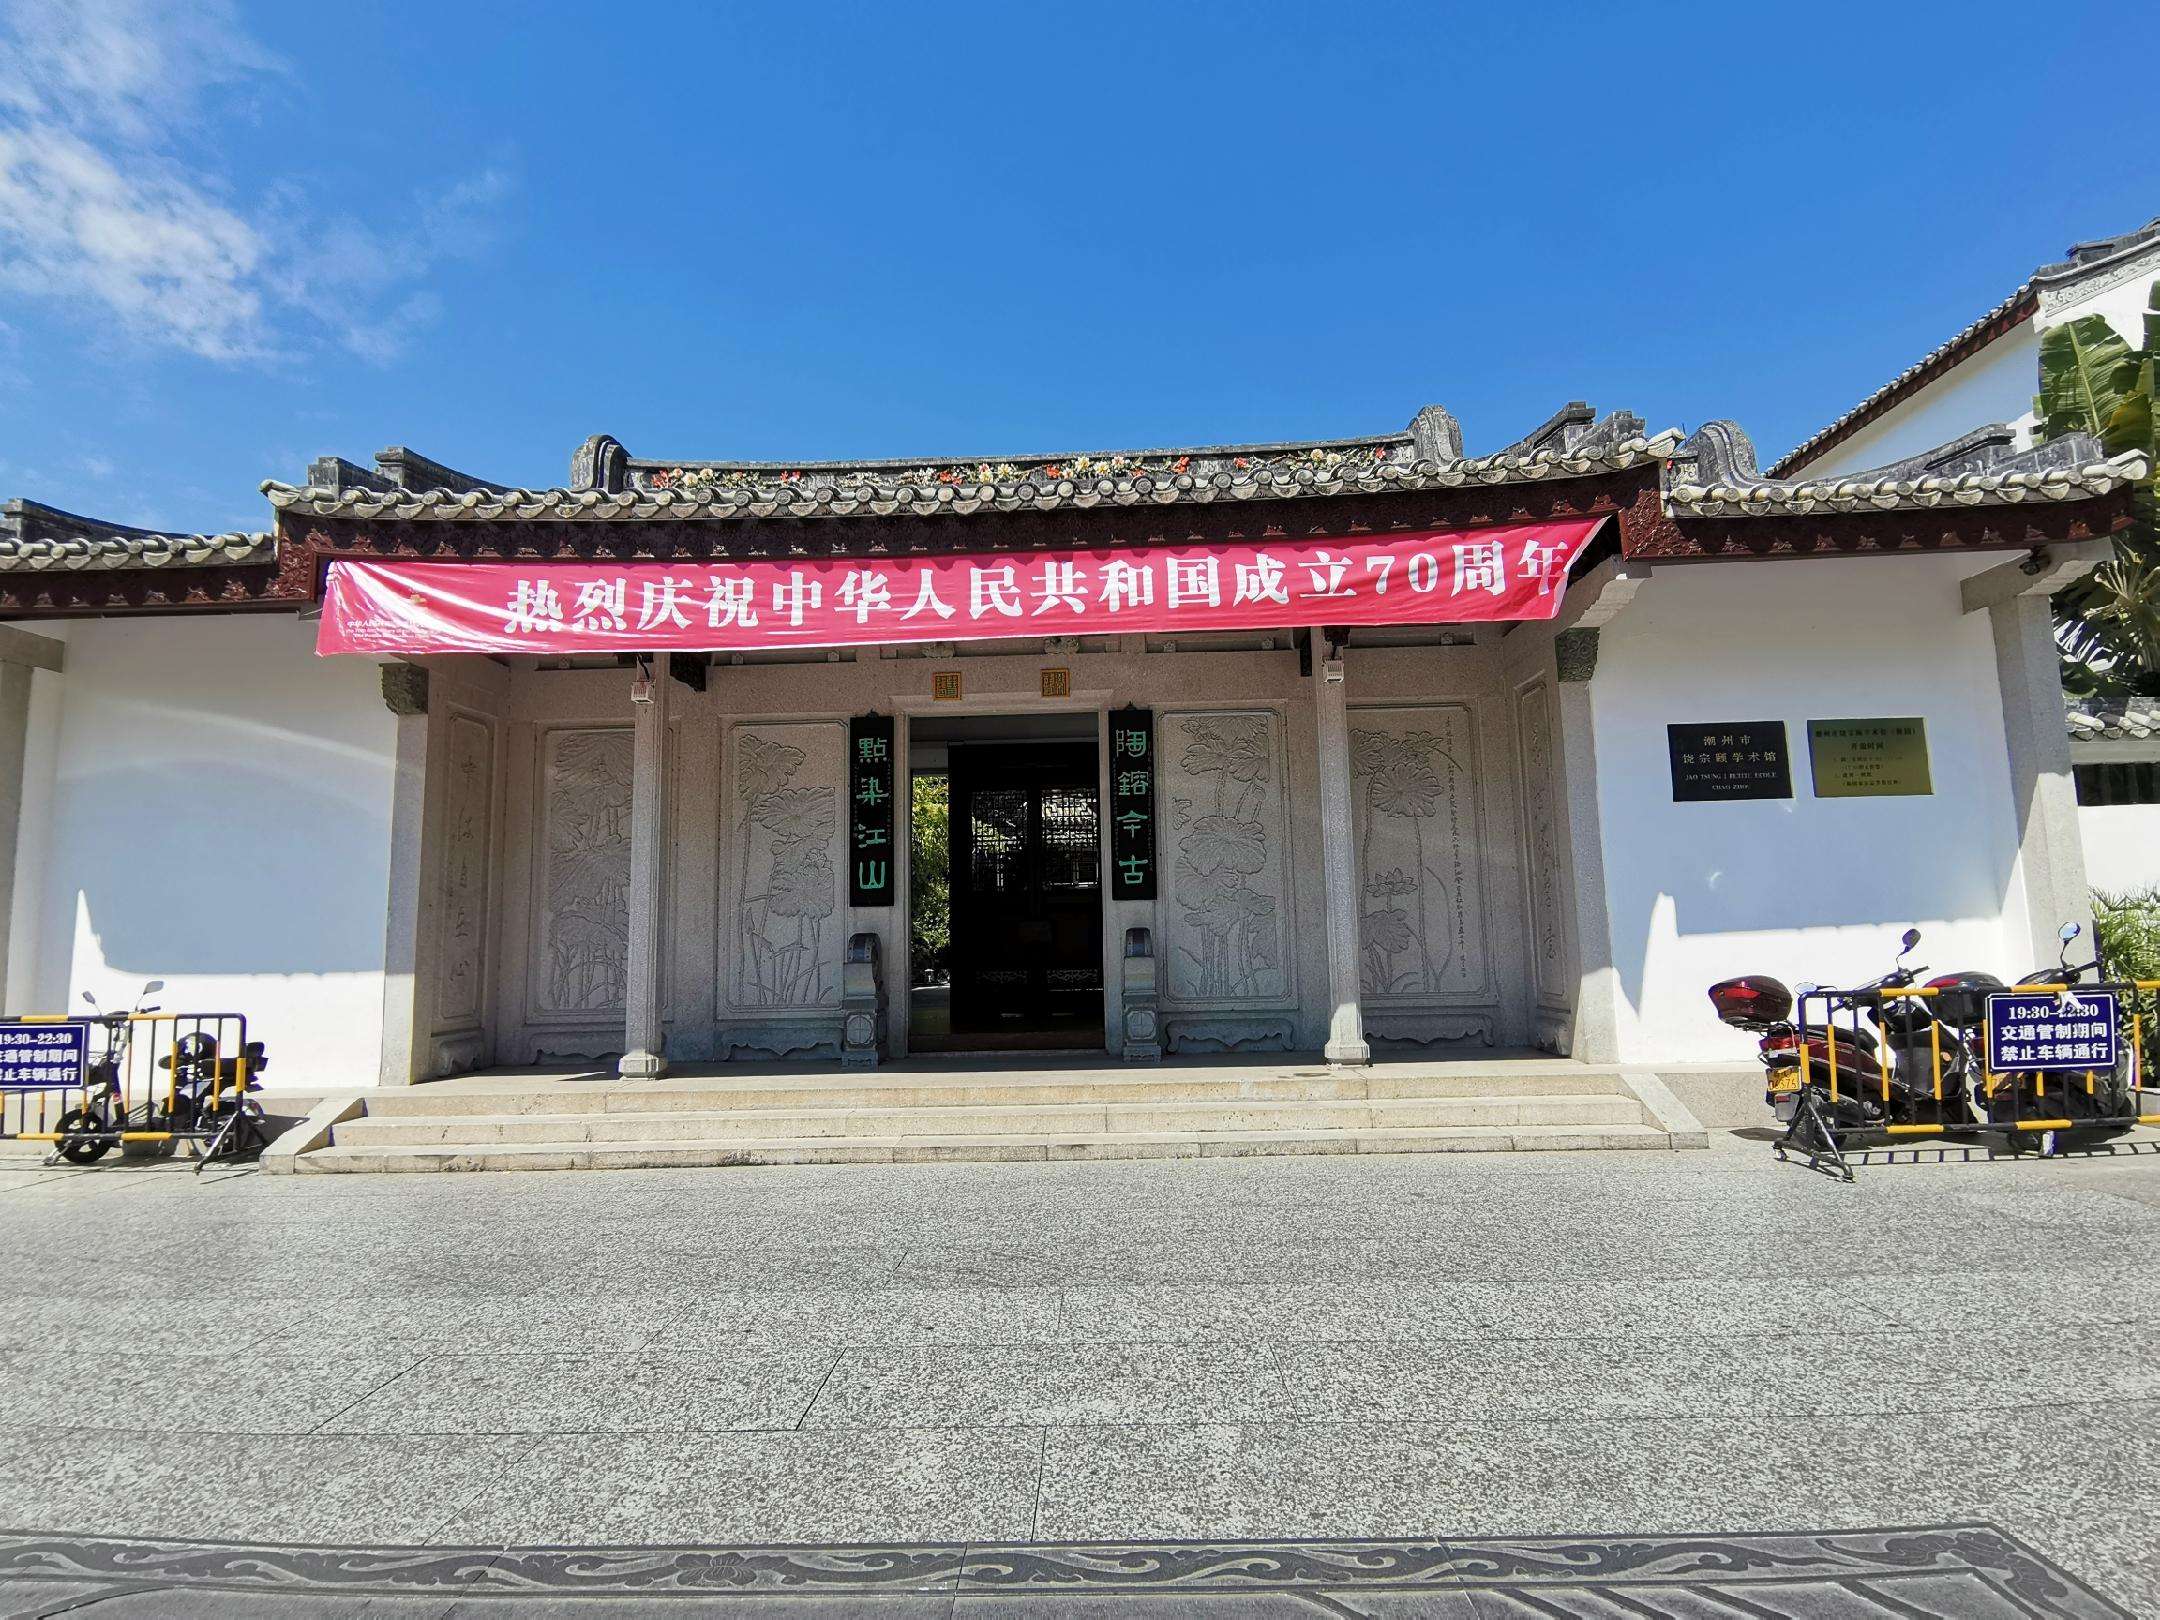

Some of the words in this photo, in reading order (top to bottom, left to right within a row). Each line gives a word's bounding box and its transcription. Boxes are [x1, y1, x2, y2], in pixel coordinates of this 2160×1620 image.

[503, 537, 1567, 633] 热烈庆祝中华人民共和国成立70周年
[2001, 1022, 2108, 1041] 交通管制期间
[2001, 1042, 2109, 1062] 禁止车辆通行
